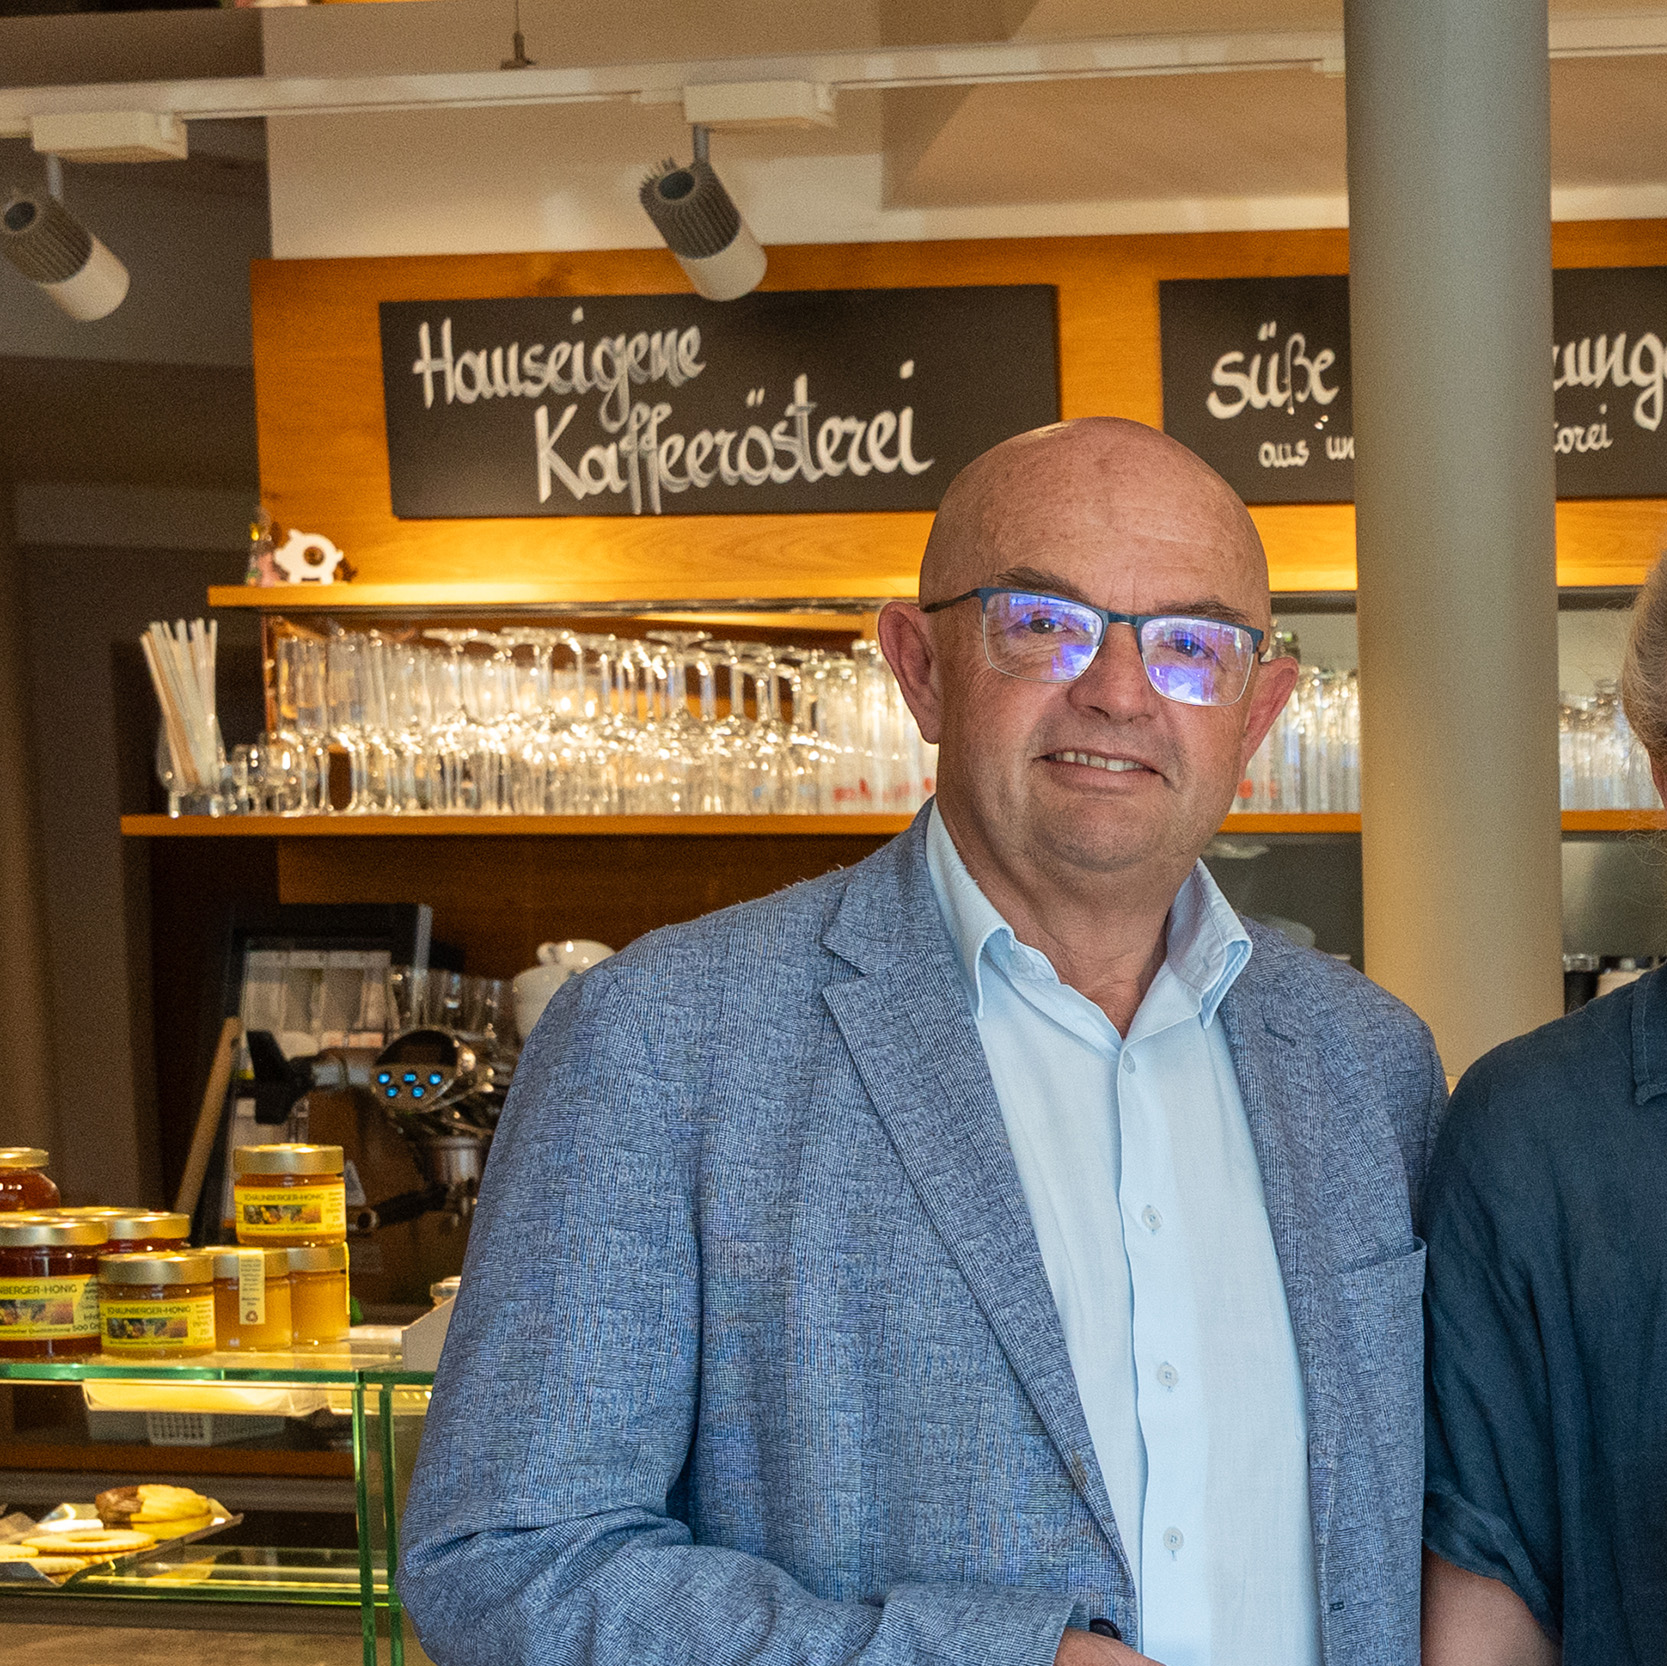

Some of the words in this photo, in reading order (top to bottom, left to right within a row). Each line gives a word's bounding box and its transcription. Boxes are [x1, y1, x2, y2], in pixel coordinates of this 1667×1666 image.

[412, 305, 707, 432] Hauseigene
[533, 357, 937, 516] Kaffeerösterei
[1257, 439, 1310, 469] aus
[1325, 435, 1356, 461] un
[1553, 403, 1614, 454] orei
